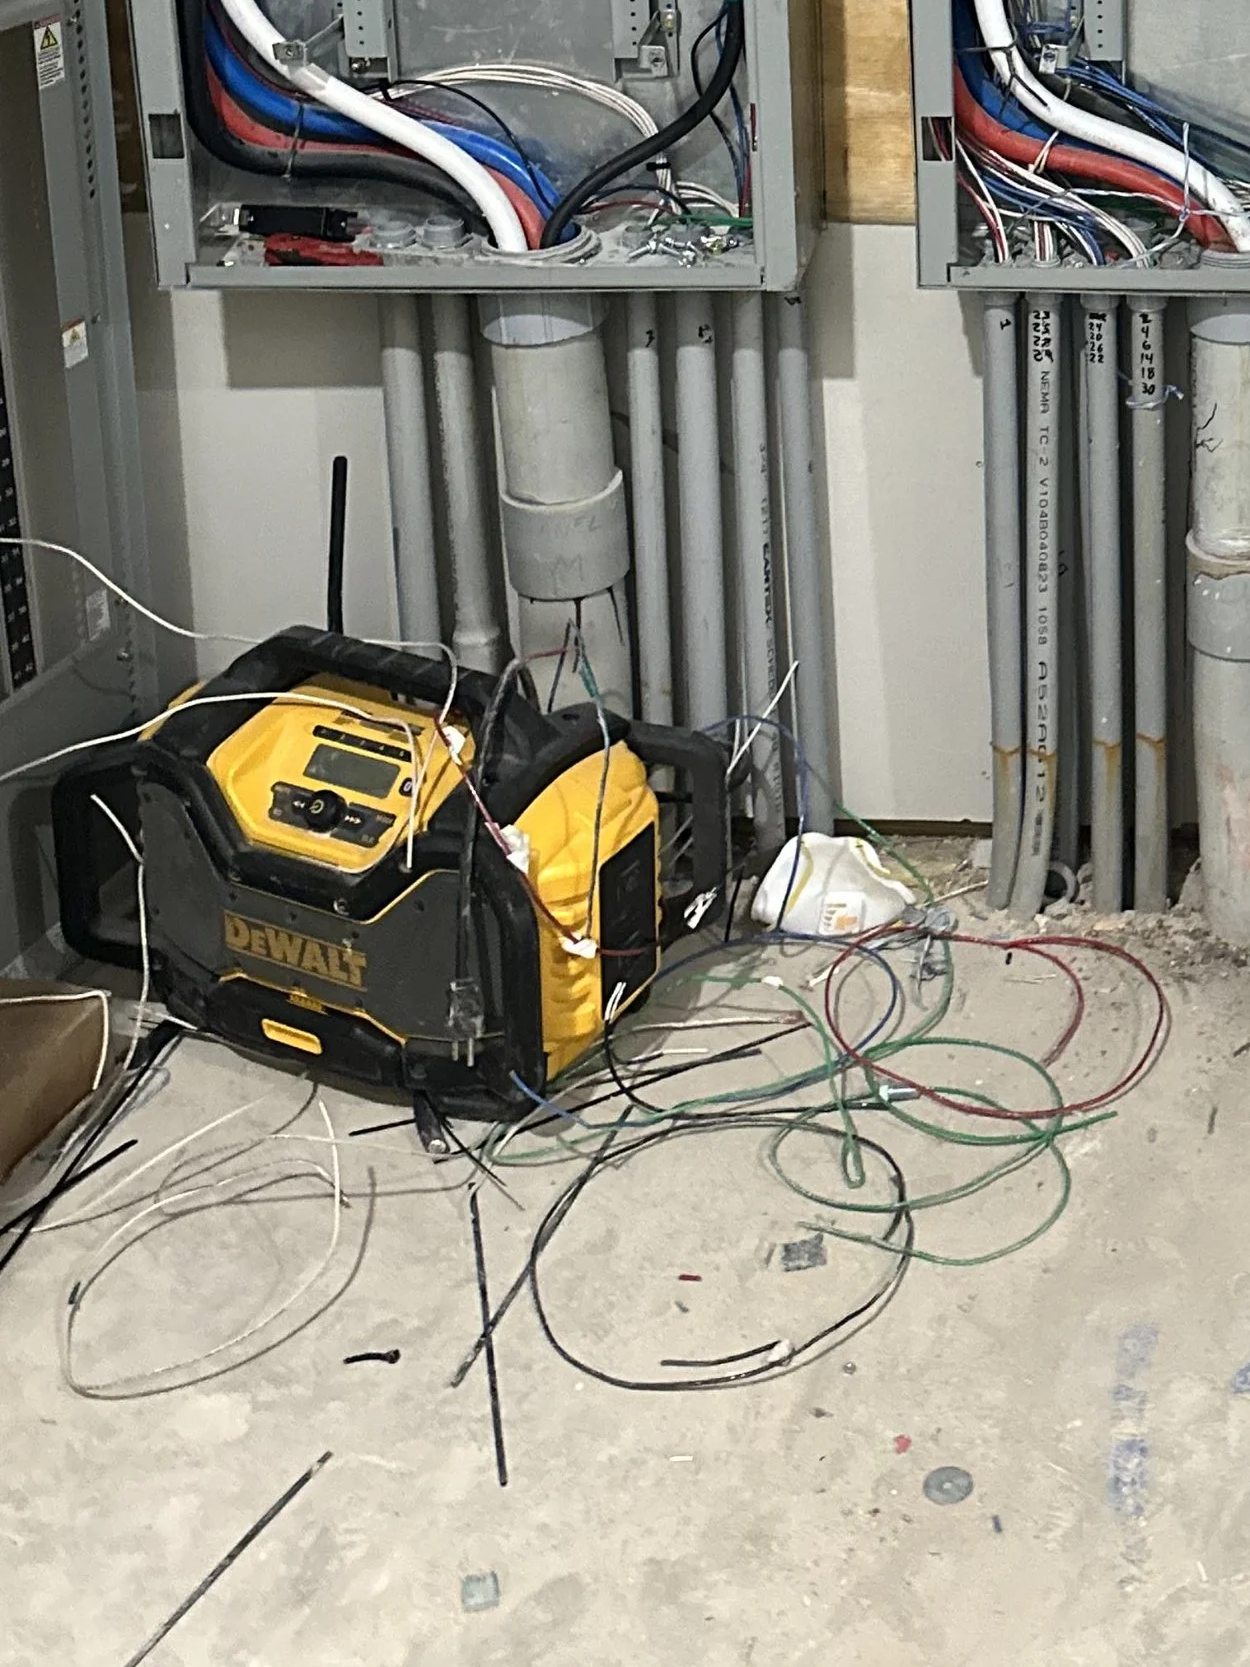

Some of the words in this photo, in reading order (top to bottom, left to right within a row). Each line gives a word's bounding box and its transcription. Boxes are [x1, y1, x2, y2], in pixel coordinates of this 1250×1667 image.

[1141, 326, 1150, 338] 4
[1142, 341, 1151, 351] 6
[1089, 353, 1104, 363] 22
[1140, 353, 1153, 364] 14
[1141, 367, 1155, 380] 18
[1040, 371, 1050, 415] NEMA
[1141, 384, 1155, 396] 30
[762, 543, 773, 623] CANTEX
